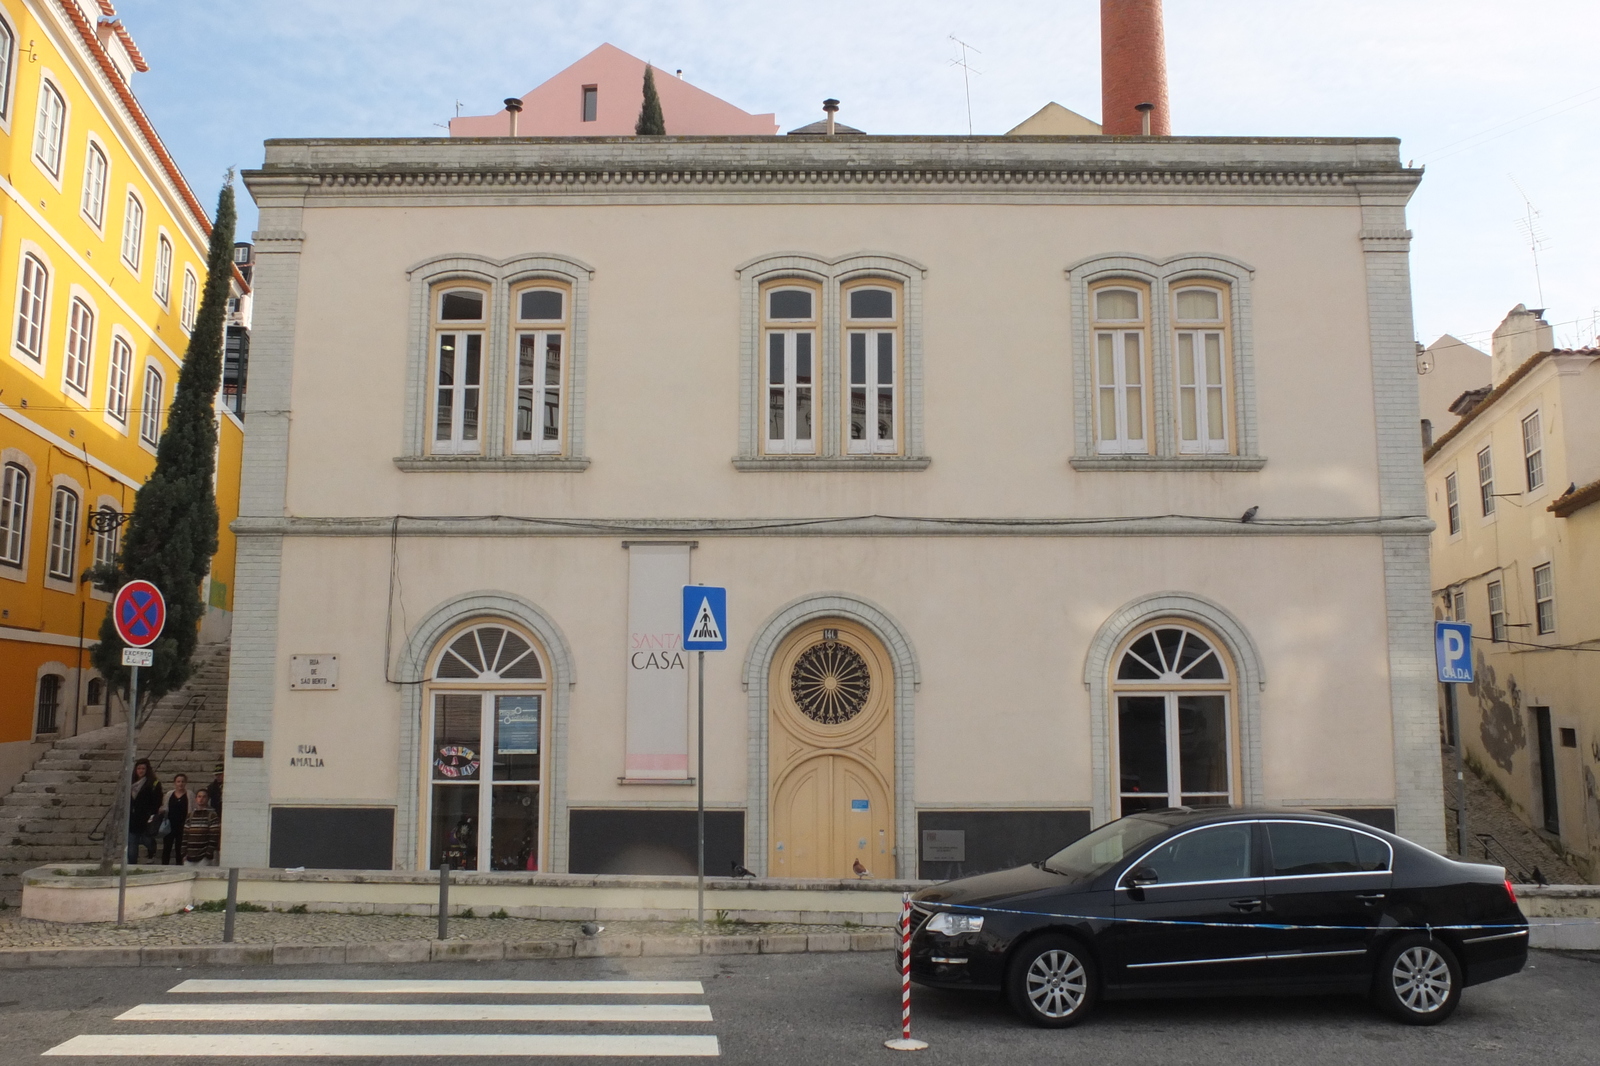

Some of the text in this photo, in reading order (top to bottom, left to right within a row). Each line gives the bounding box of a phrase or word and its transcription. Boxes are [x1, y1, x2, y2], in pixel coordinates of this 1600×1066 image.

[631, 633, 682, 649] SANTA
[1443, 629, 1464, 676] P
[631, 651, 685, 670] CASA
[310, 668, 318, 676] DE
[312, 677, 327, 685] BENTO
[298, 745, 317, 755] RUA
